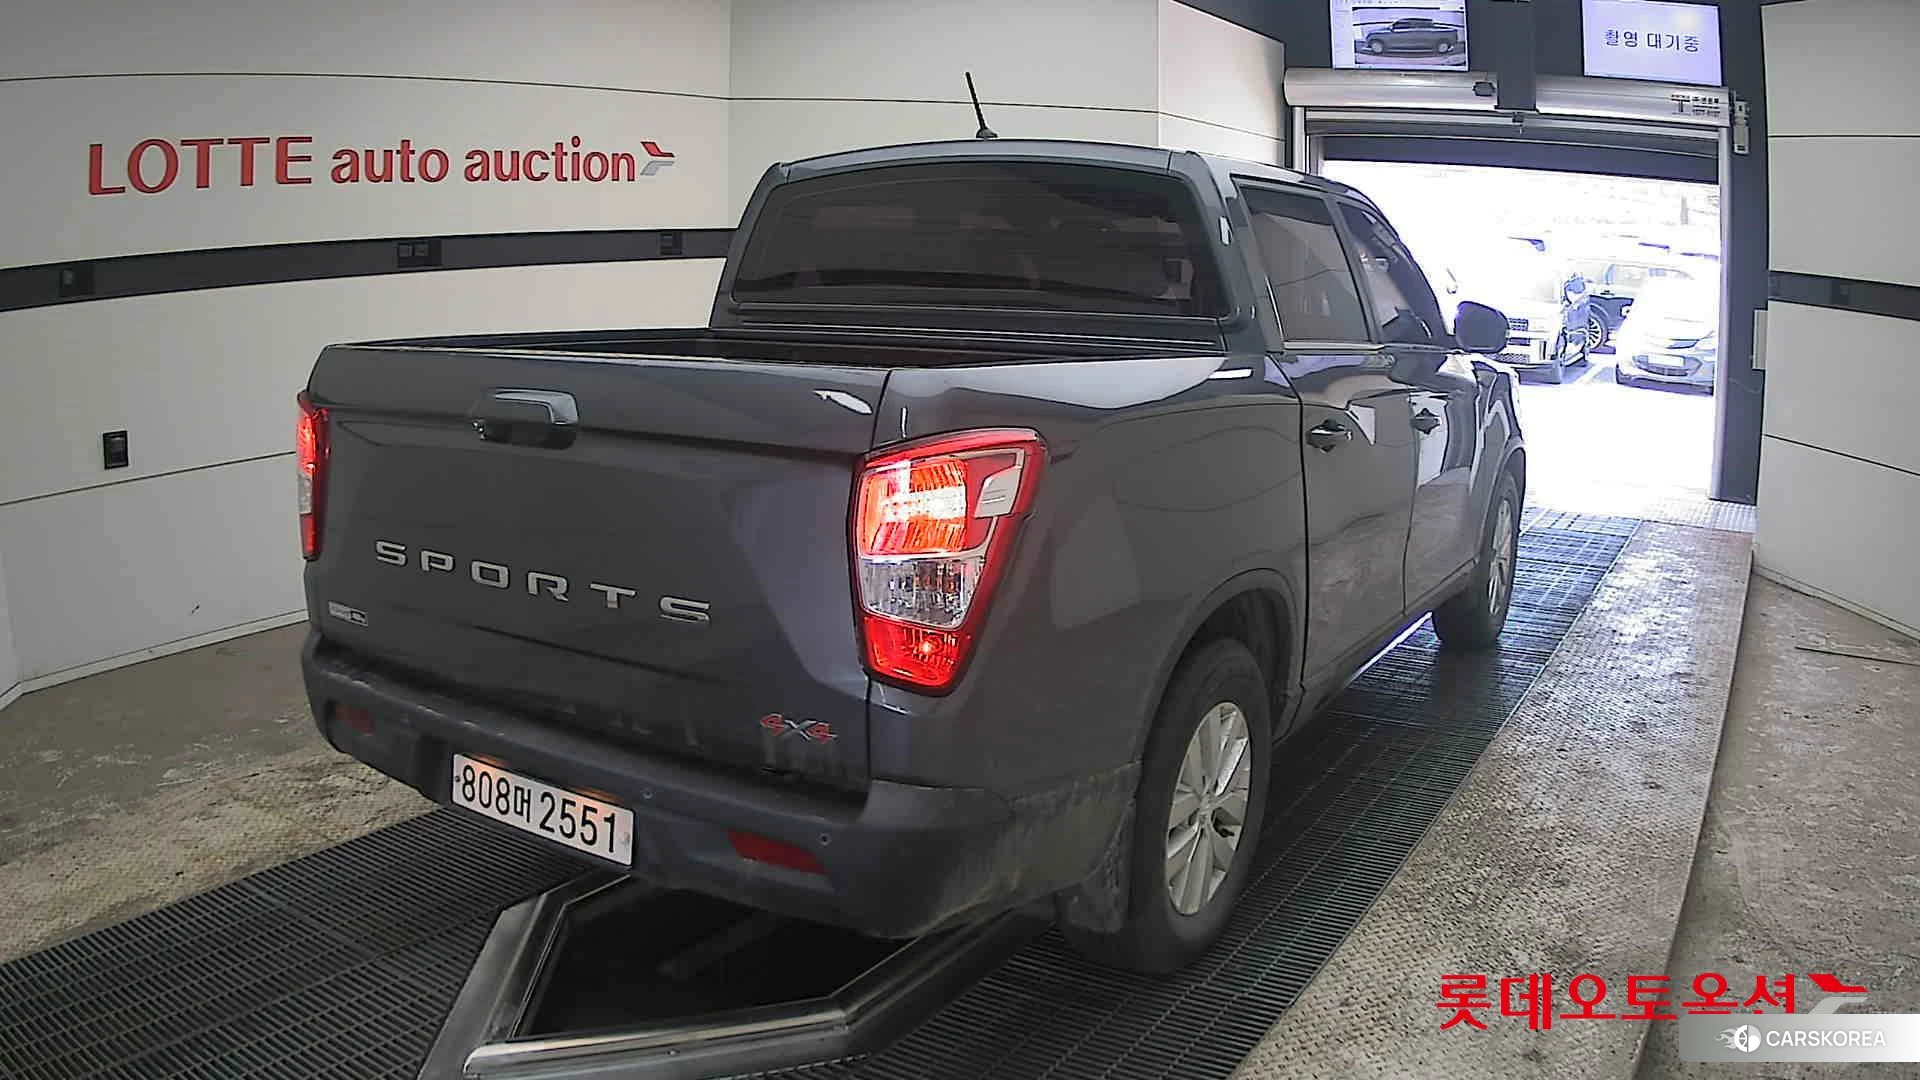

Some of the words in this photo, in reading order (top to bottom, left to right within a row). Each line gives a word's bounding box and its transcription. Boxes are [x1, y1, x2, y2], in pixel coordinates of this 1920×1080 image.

[1646, 33, 1699, 53] 대기중
[88, 136, 313, 196] LOTTE
[331, 140, 449, 184] auto
[464, 136, 636, 184] auction
[374, 540, 712, 624] SPORTS
[539, 791, 616, 854] 2551
